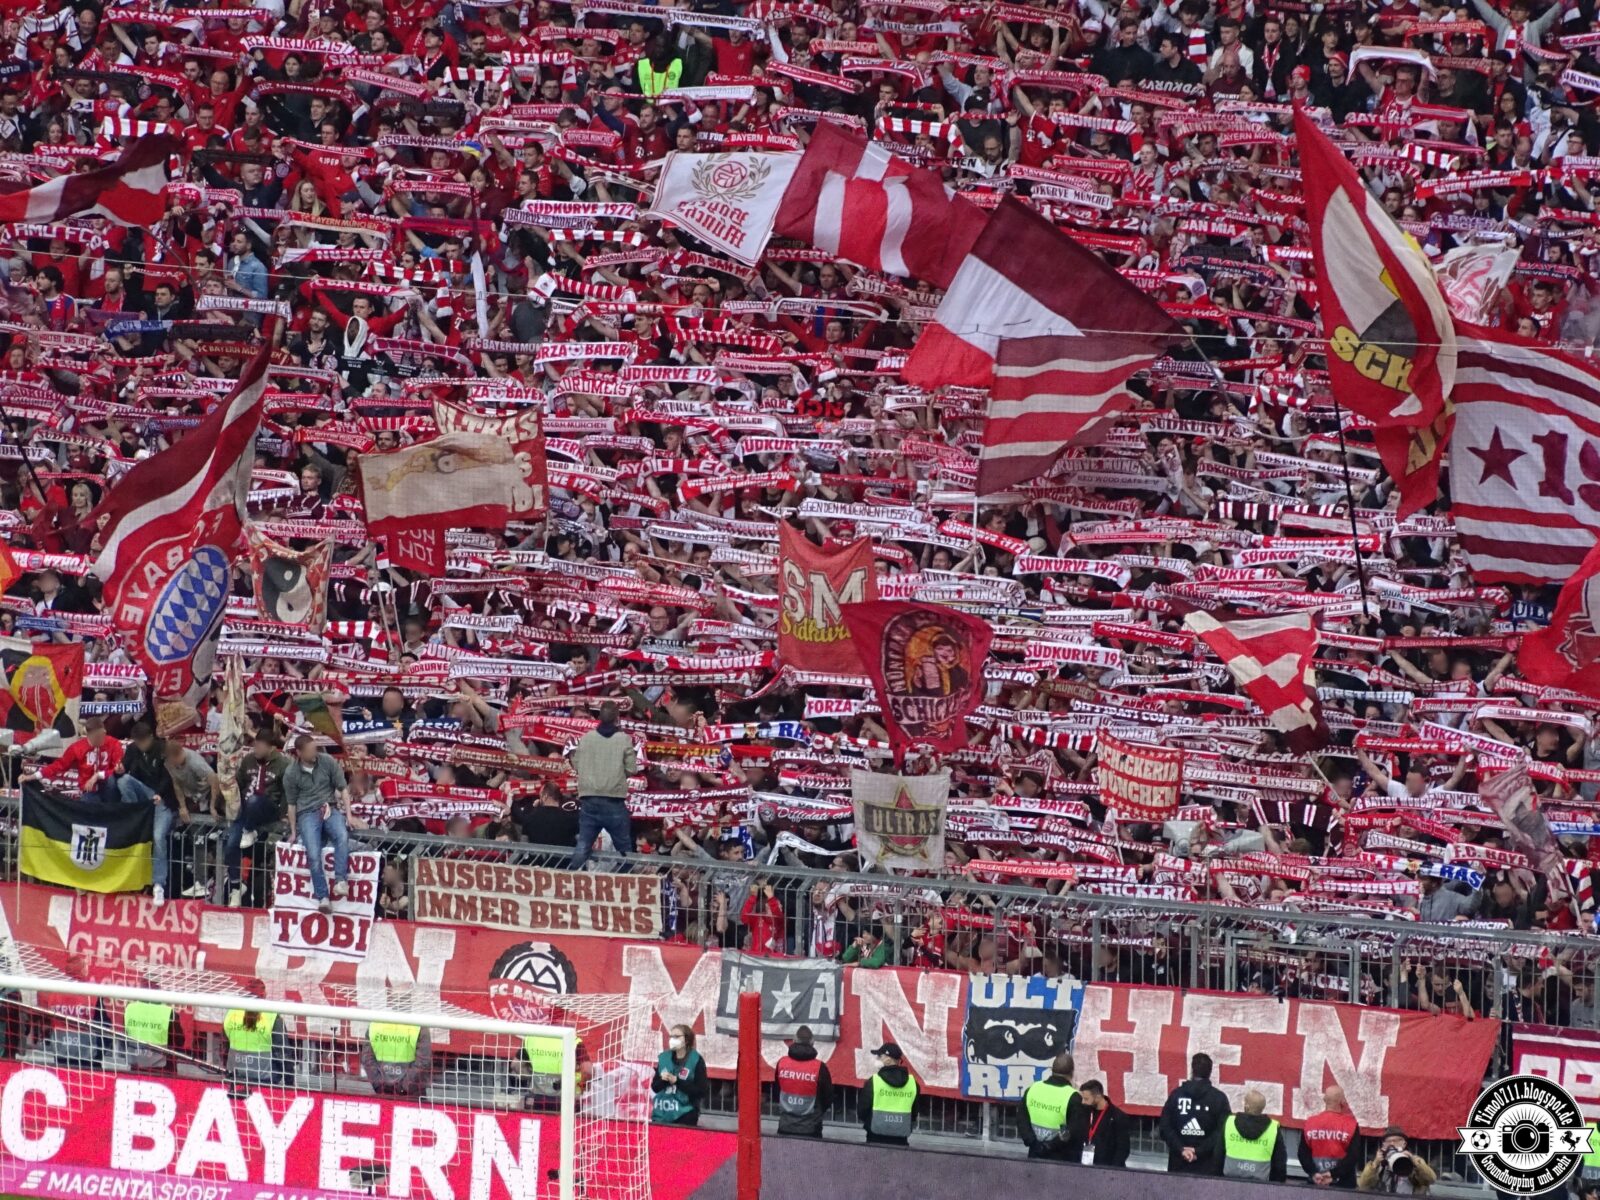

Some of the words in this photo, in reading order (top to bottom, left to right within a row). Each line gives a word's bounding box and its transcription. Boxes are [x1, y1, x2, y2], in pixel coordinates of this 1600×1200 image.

[246, 36, 345, 53] REKORDMEIS
[512, 107, 540, 116] AYERN
[731, 133, 763, 141] BAYERN
[233, 207, 261, 216] AYERN
[603, 204, 633, 215] 1972
[202, 295, 244, 309] DKURVE
[536, 346, 565, 359] RZA
[1094, 562, 1124, 579] 1972
[1263, 568, 1277, 578] 19
[1025, 644, 1098, 661] SÜDKURVE
[86, 664, 142, 678] DKURVE
[985, 670, 1010, 679] CON
[808, 701, 852, 713] FORZA
[277, 848, 310, 870] WI
[324, 853, 377, 876] SND
[416, 860, 658, 905] AUSGESPERRTE
[1441, 865, 1483, 889] RAS
[275, 872, 312, 898] BE
[75, 894, 199, 934] ULTRAS
[418, 890, 520, 926] IMMER
[530, 901, 580, 929] BEI
[590, 905, 654, 934] UNS
[274, 910, 372, 952] TOBI
[68, 932, 199, 971] GEGEN
[971, 975, 1081, 1009] ULT
[374, 1034, 410, 1043] Steward
[780, 1070, 817, 1081] SERVICE
[968, 1065, 1050, 1099] RA
[879, 1089, 912, 1098] Steward
[1030, 1100, 1061, 1113] Steward
[111, 1079, 541, 1200] BAYERN
[1230, 1133, 1268, 1146] Steward
[1307, 1130, 1348, 1142] SERVICE
[47, 1171, 155, 1200] MAGENTA
